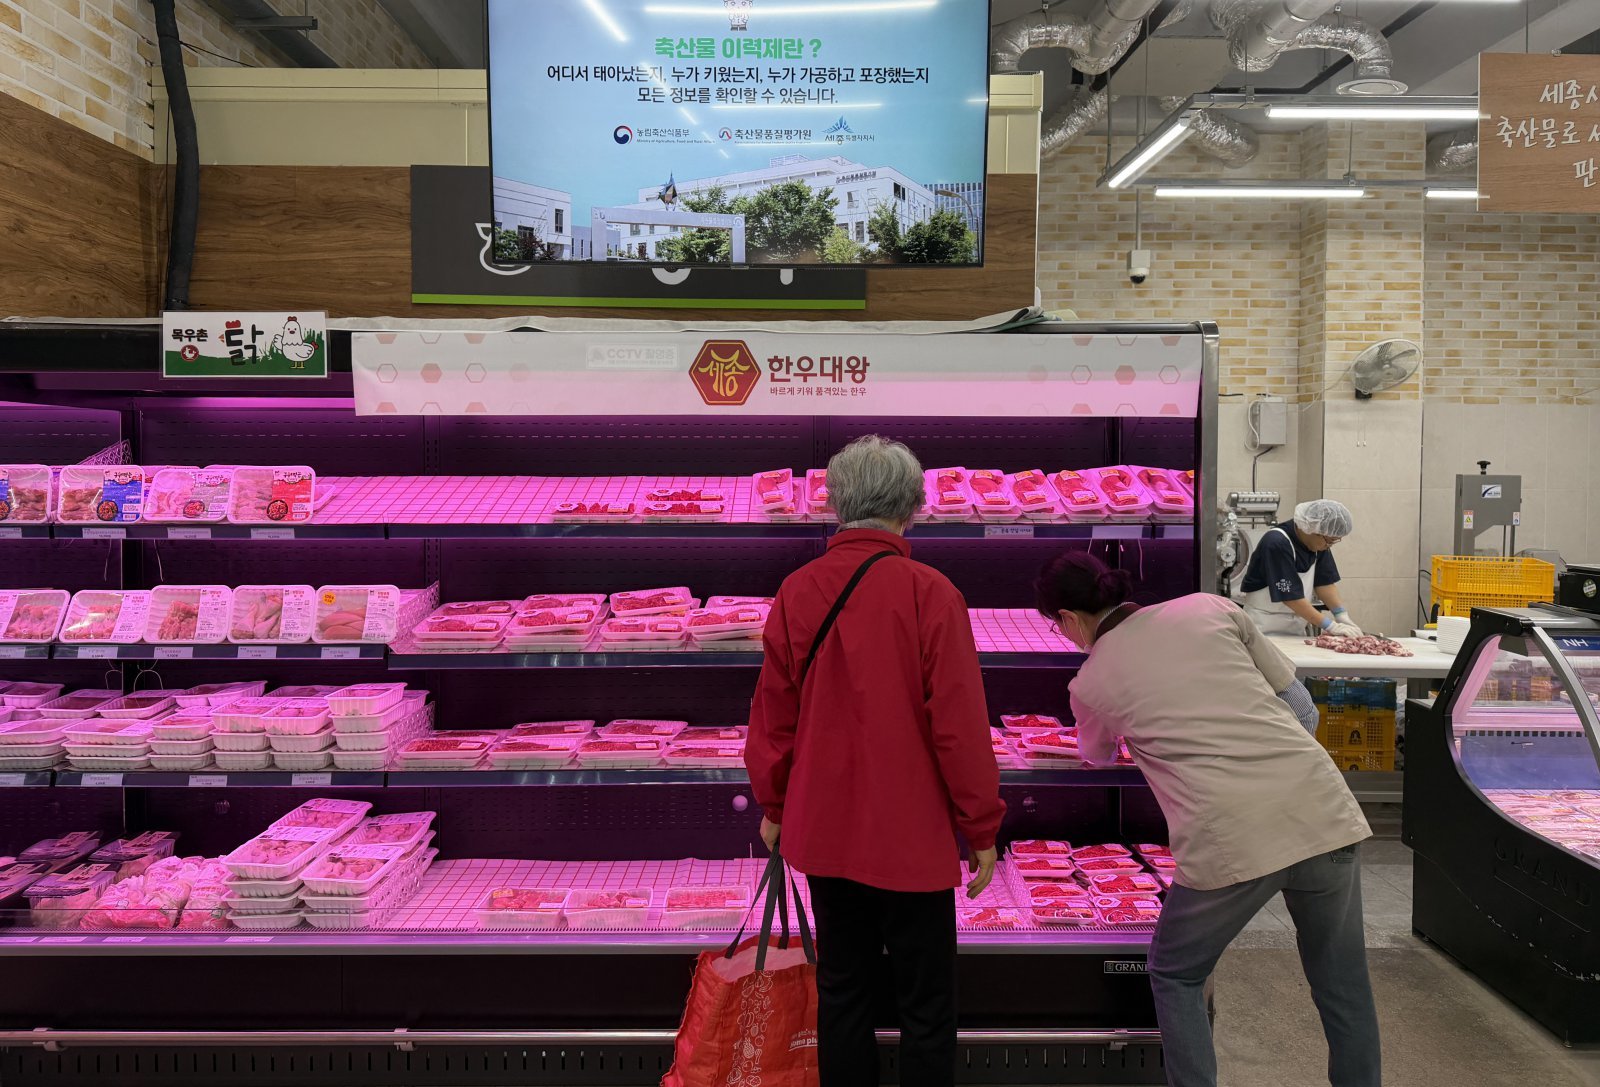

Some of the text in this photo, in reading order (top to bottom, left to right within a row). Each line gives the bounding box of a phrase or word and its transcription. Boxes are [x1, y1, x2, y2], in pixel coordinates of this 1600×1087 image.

[655, 37, 822, 59] 축산물 이력제란 ?
[547, 65, 929, 84] 어디서 태아났는지, 누가 키웠는지, 누가 가공하고 포장했는지
[637, 87, 839, 104] 모든 정보를 확인할 수 있습니다.
[636, 128, 690, 138] 농림축산식품부
[734, 129, 812, 140] 축산물품질평가원
[1496, 115, 1581, 148] 축산물로
[171, 328, 208, 342] 목우촌
[224, 320, 265, 365] 닭
[607, 348, 642, 359] CCTV
[767, 355, 870, 384] 한우대왕
[770, 387, 867, 397] 바르게 키워 품격있는 한우
[1562, 638, 1589, 647] NH
